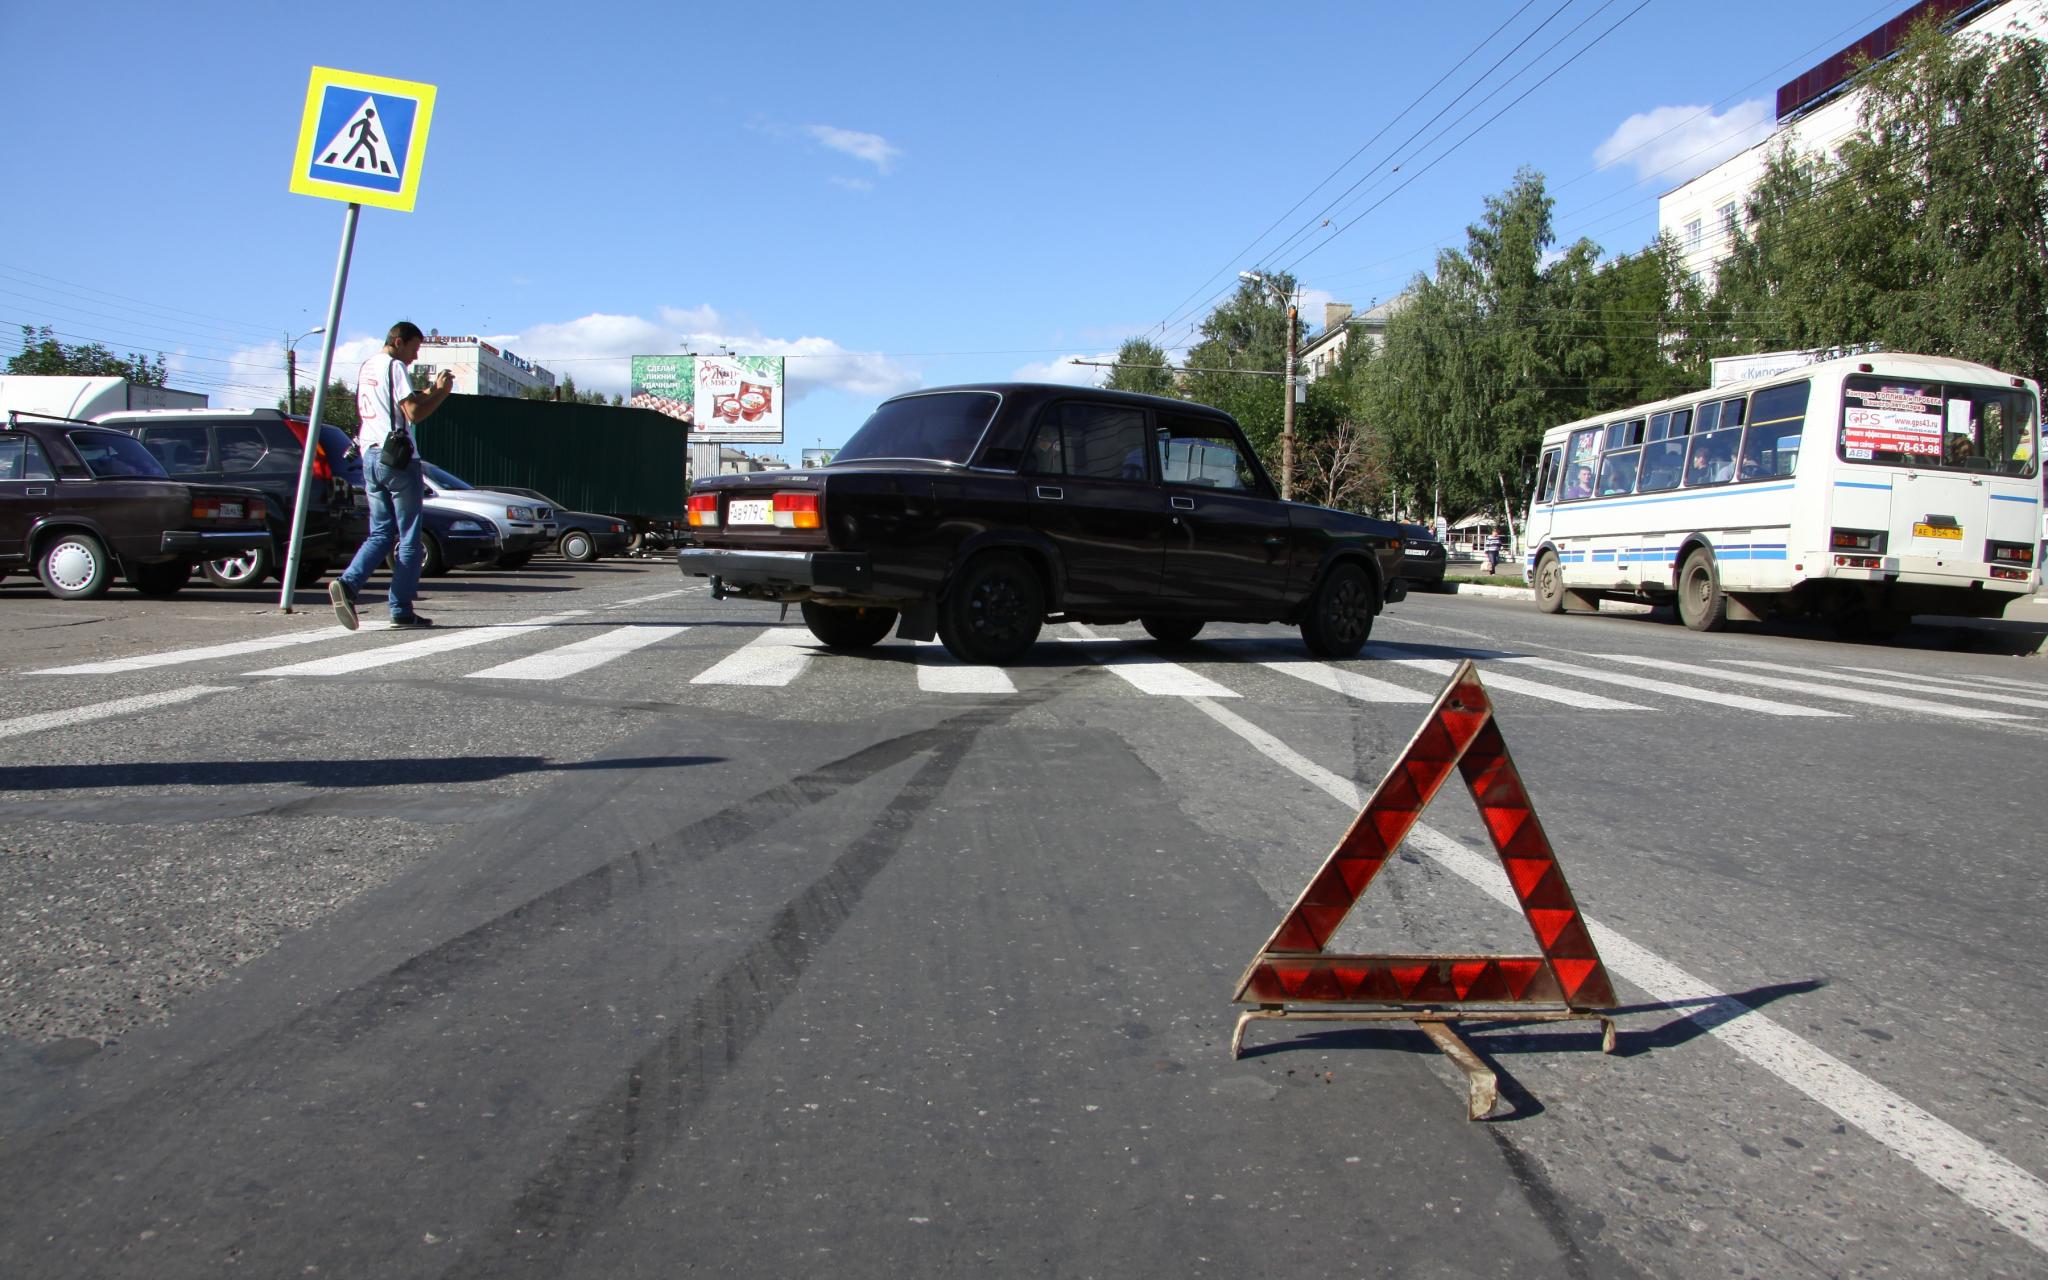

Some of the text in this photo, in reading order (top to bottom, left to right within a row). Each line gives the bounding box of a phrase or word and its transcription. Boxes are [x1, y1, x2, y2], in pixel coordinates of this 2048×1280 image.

[647, 364, 676, 372] СДЕЛАЙ
[1877, 392, 1907, 401] ТОПЛИВА
[1848, 412, 1880, 425] GPS
[1894, 418, 1938, 428] www.gps43.ru
[1897, 442, 1940, 454] 78-63-98
[1848, 449, 1871, 458] ABS
